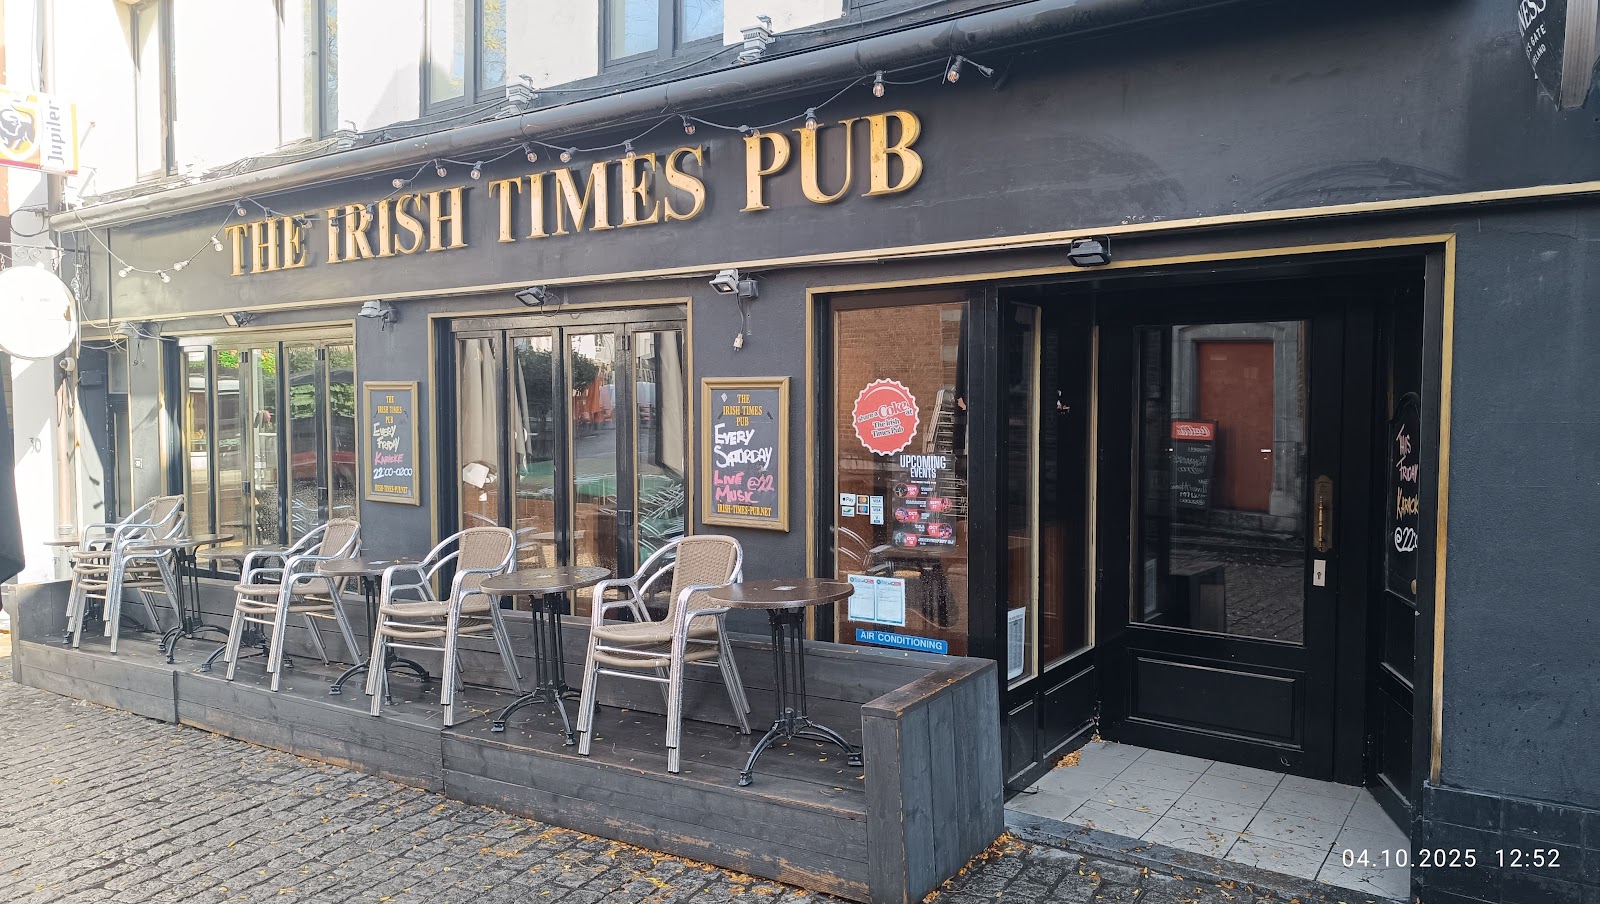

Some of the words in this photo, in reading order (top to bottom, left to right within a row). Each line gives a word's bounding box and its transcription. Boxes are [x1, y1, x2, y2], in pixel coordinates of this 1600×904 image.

[1530, 24, 1547, 46] GATE
[46, 99, 66, 165] Jupiler
[224, 212, 307, 277] THE
[325, 185, 468, 265] IRISH
[488, 144, 706, 243] TIMES
[739, 109, 924, 212] PUB
[736, 393, 751, 404] THE
[722, 405, 741, 416] IRISH
[741, 405, 763, 416] TIMES
[878, 400, 907, 419] Coke
[905, 407, 913, 415] at
[736, 416, 750, 427] PUB
[714, 422, 756, 446] EVERY
[899, 454, 947, 470] UPCOMING
[713, 469, 745, 486] LIVE
[910, 468, 937, 479] EVENTS
[860, 630, 875, 641] AIR
[877, 632, 943, 651] CONDITIONING
